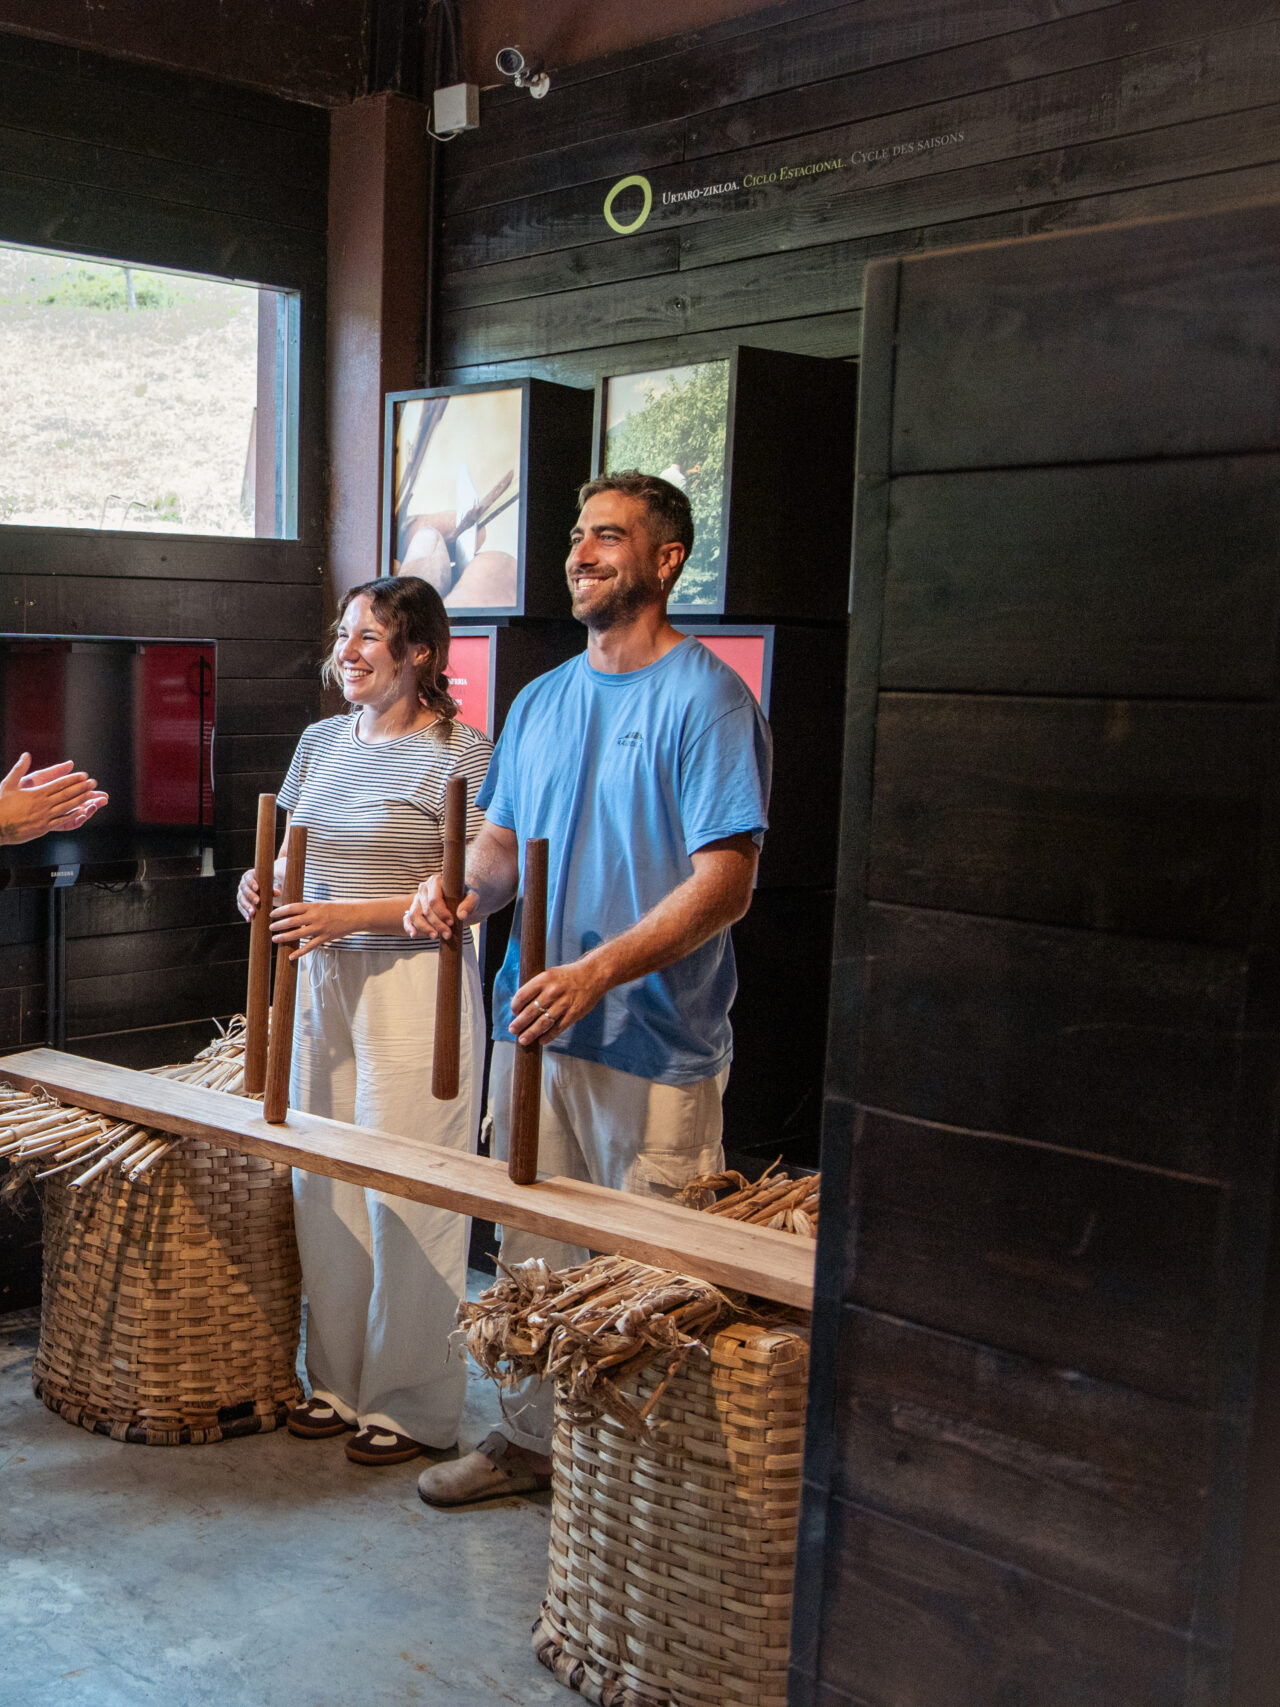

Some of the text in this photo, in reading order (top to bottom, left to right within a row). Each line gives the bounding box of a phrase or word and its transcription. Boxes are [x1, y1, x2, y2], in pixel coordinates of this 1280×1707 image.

[743, 174, 777, 188] CICLO
[780, 158, 847, 181] ESTACIONAL.
[851, 151, 890, 165] CYCLE
[893, 142, 914, 157] DES
[917, 131, 965, 151] SAISONS
